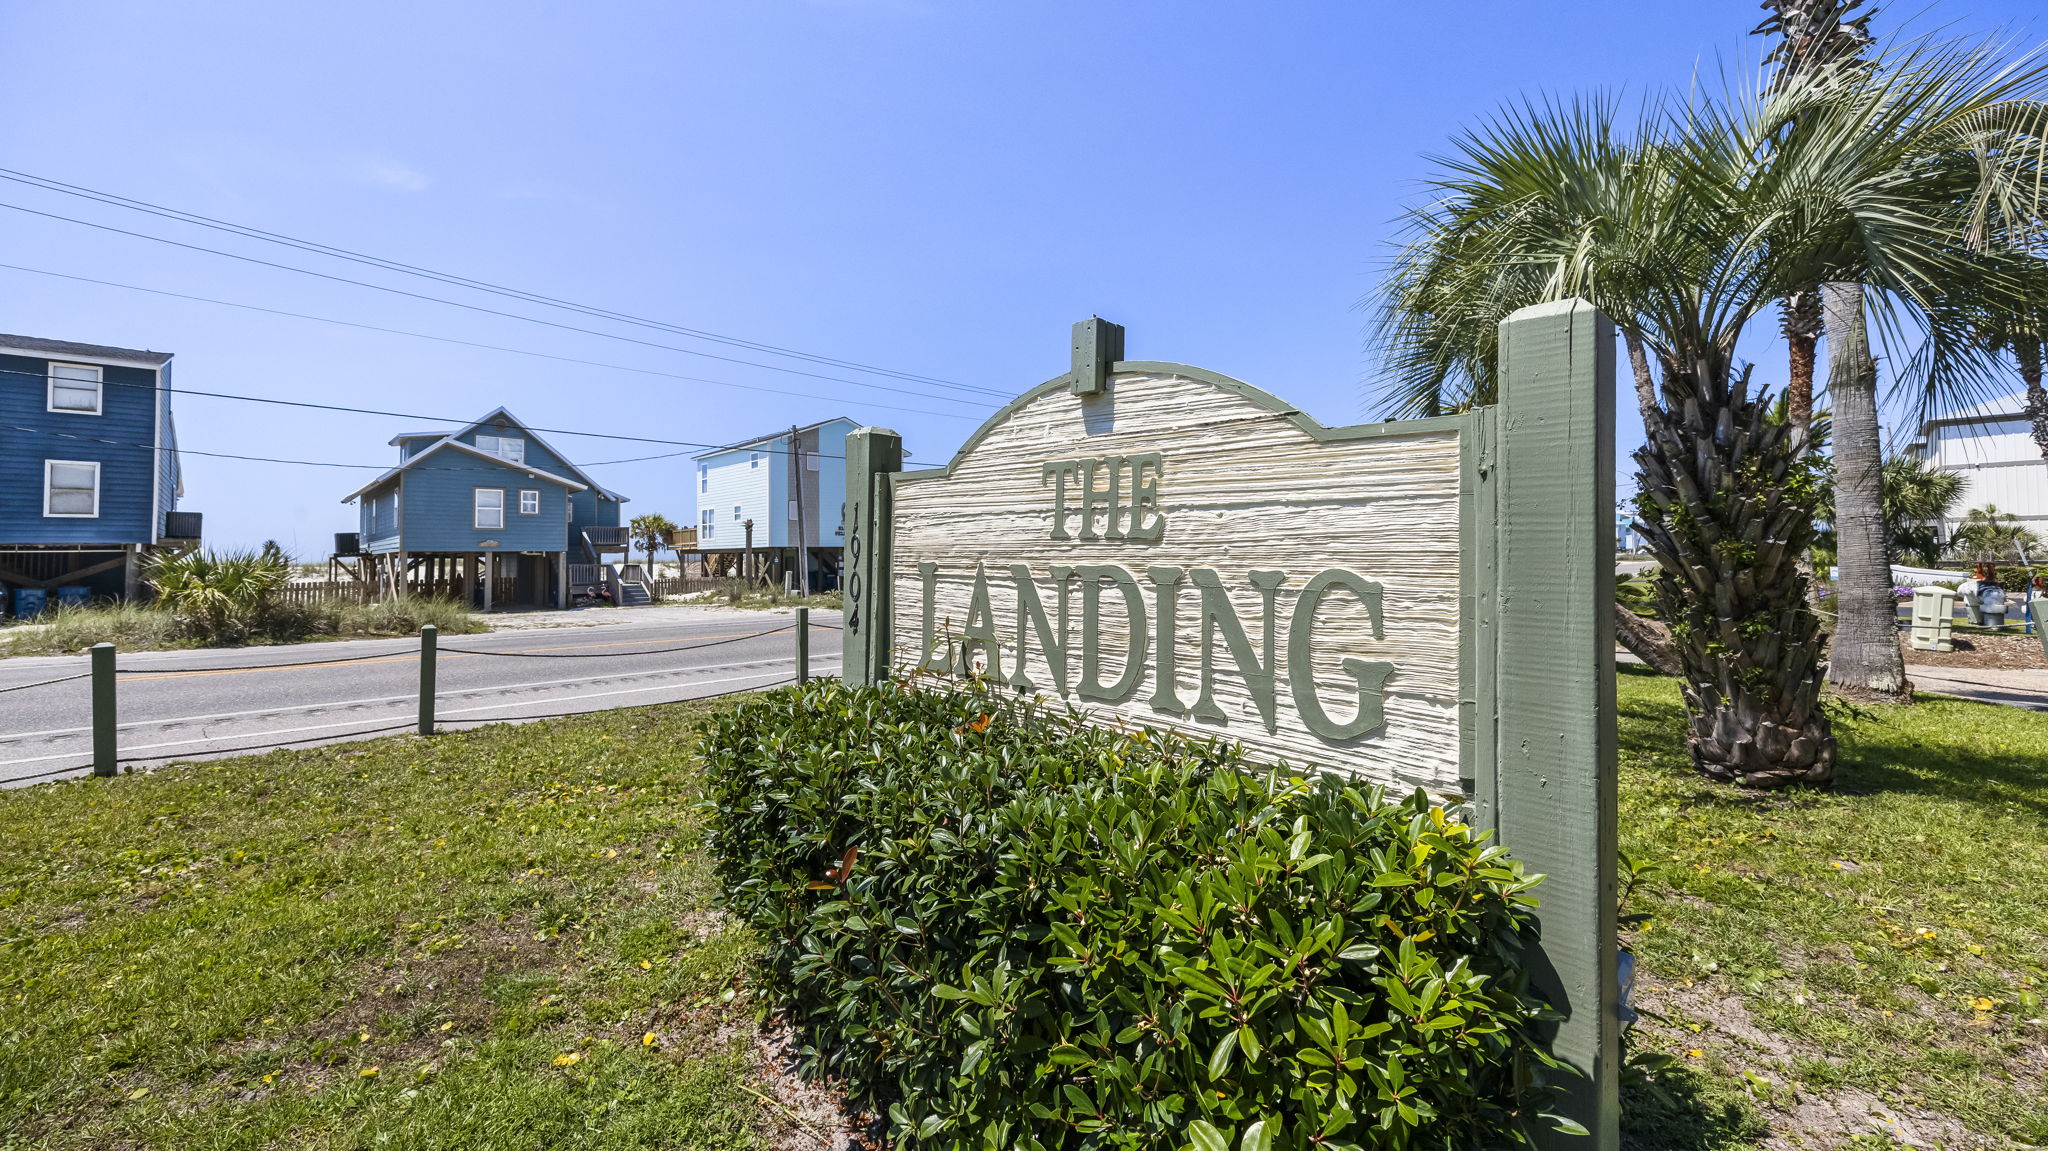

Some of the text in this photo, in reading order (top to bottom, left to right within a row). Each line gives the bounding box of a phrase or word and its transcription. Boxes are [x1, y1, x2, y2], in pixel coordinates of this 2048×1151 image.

[1042, 452, 1165, 540] THE
[849, 502, 861, 636] 1904
[917, 561, 1394, 741] LANDING
